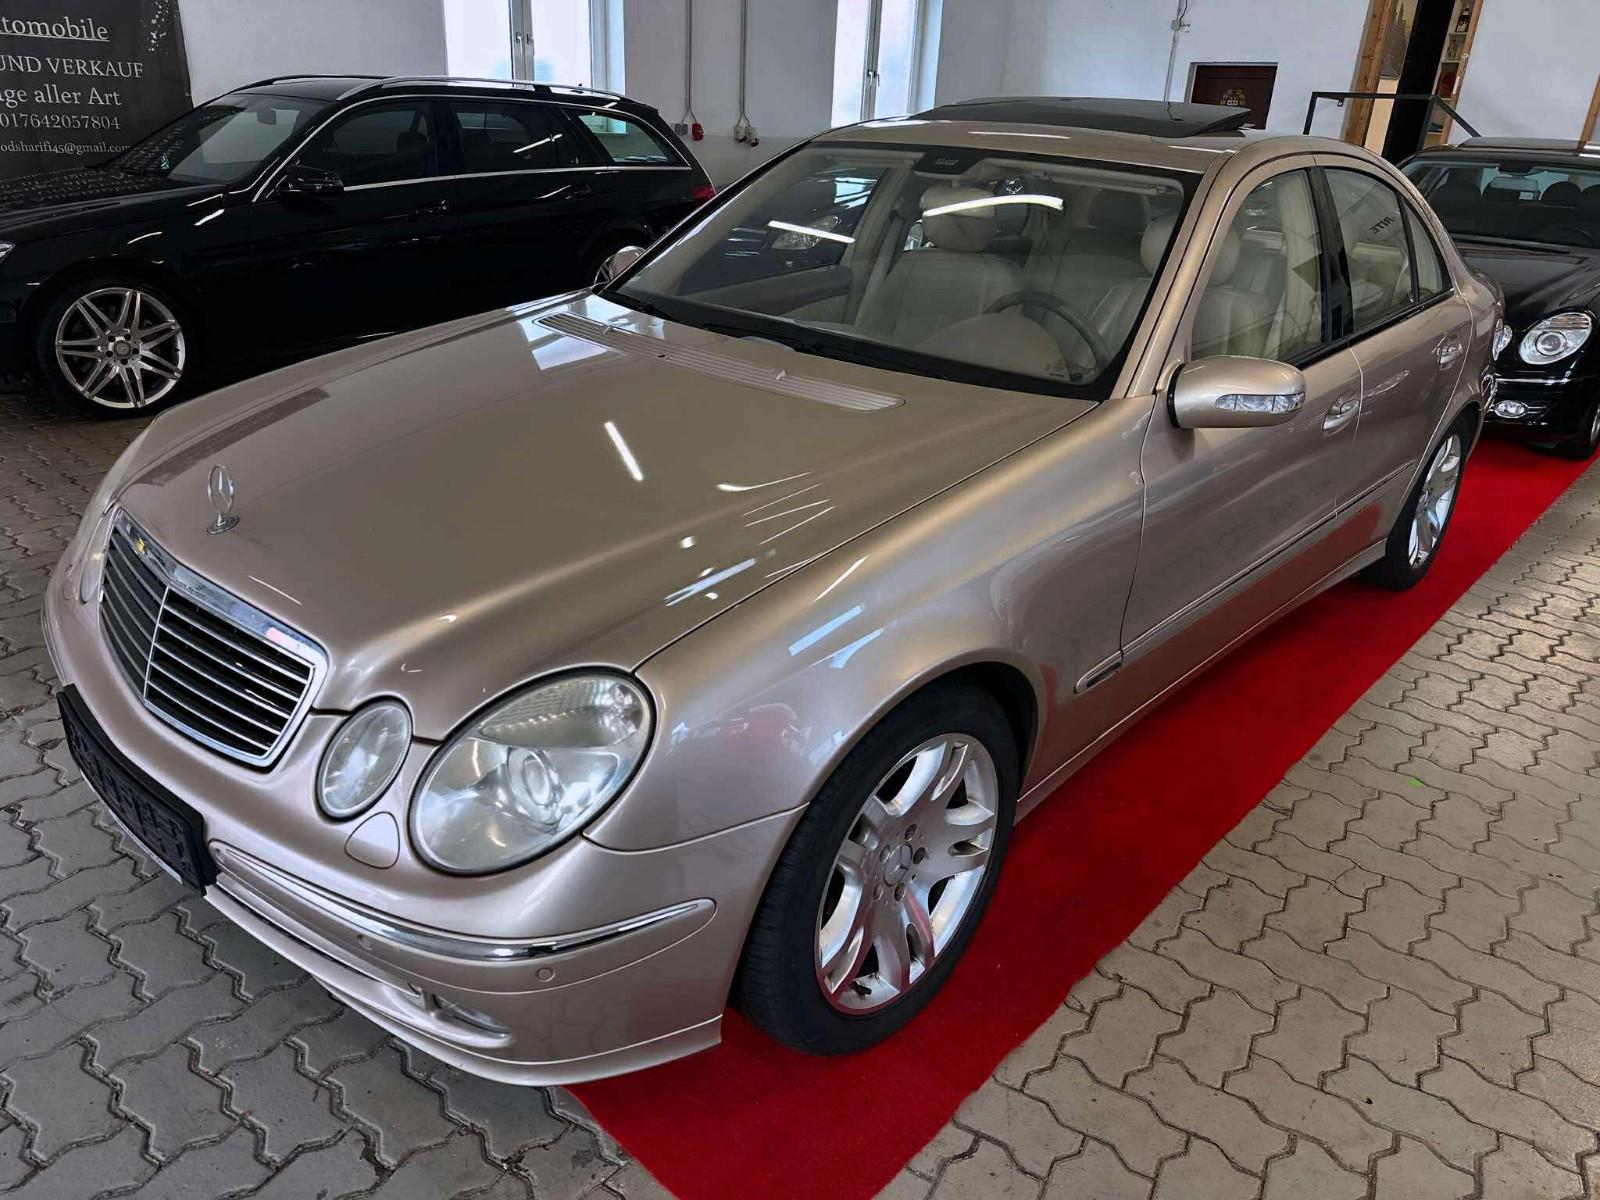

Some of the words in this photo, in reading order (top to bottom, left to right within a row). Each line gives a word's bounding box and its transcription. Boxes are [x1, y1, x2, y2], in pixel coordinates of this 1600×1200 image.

[0, 16, 109, 40] tomobile
[46, 57, 143, 78] VERKAUF
[34, 84, 82, 105] aller
[87, 87, 122, 106] Art
